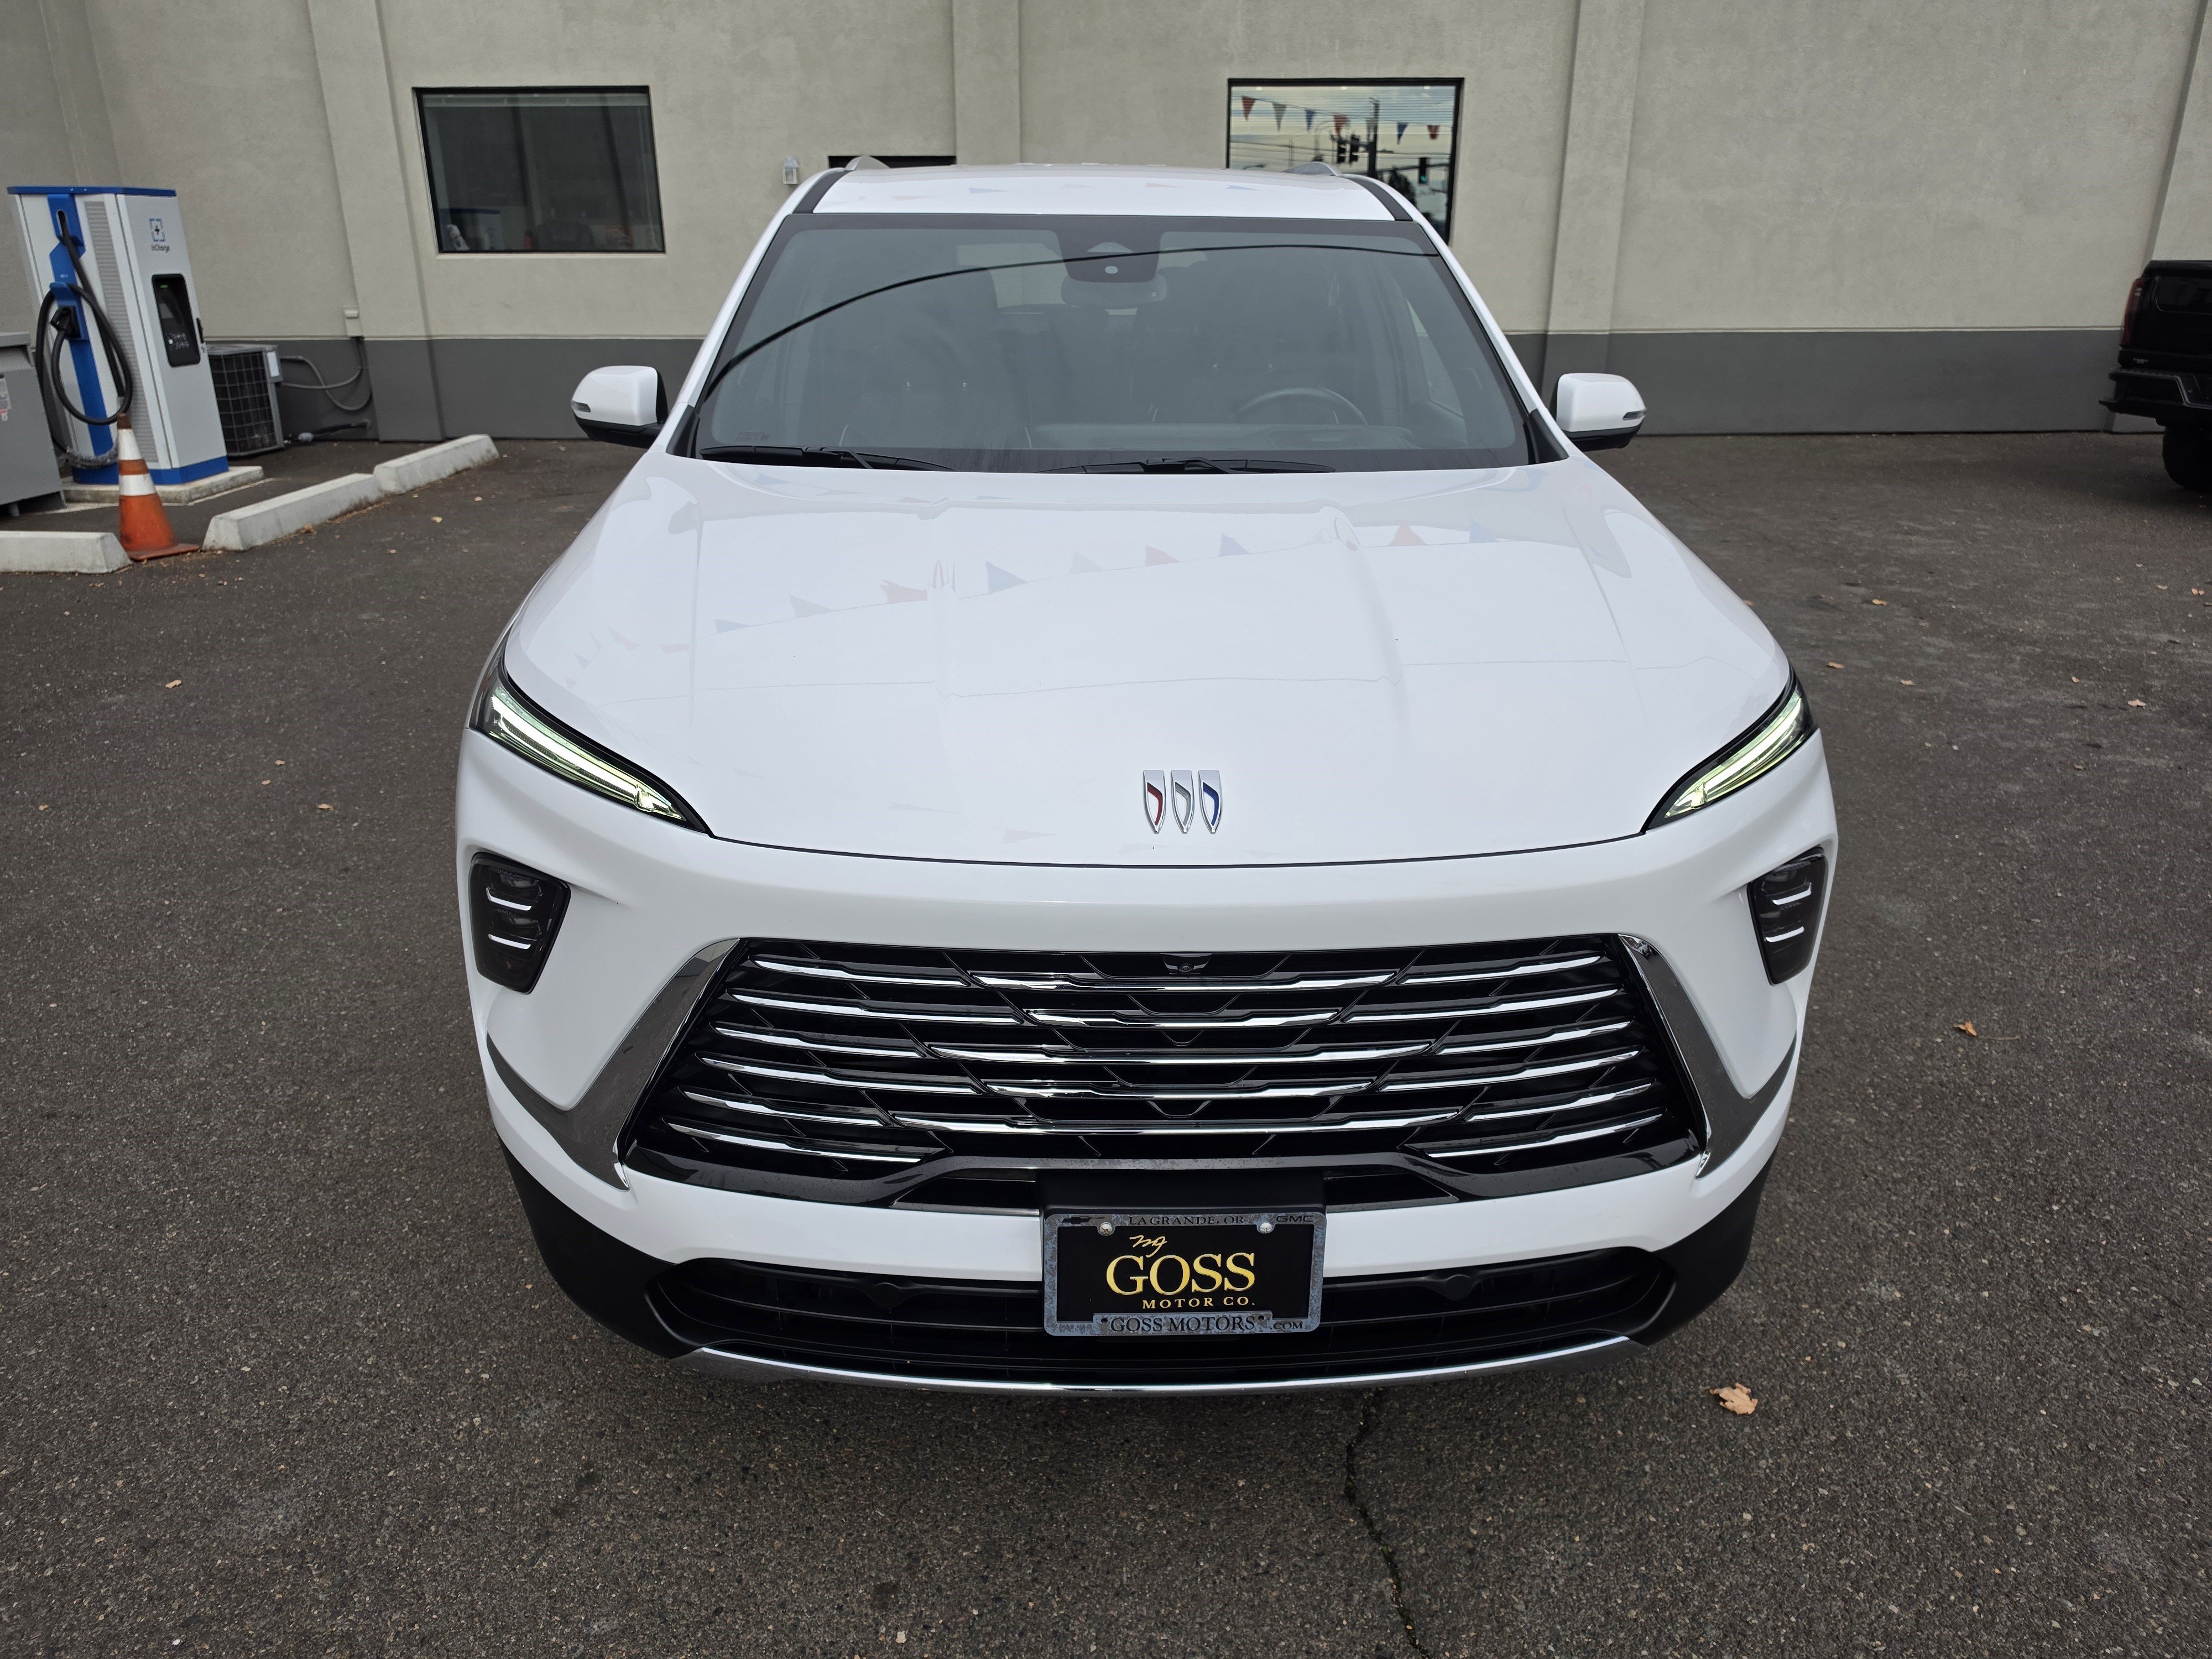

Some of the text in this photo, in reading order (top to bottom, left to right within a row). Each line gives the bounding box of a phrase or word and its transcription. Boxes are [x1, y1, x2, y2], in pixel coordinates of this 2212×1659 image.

[1106, 1253, 1255, 1295] GOSS
[1142, 1296, 1255, 1309] MOTOR CO.
[1110, 1317, 1162, 1332] GOSS
[1169, 1316, 1255, 1332] MOTORS
